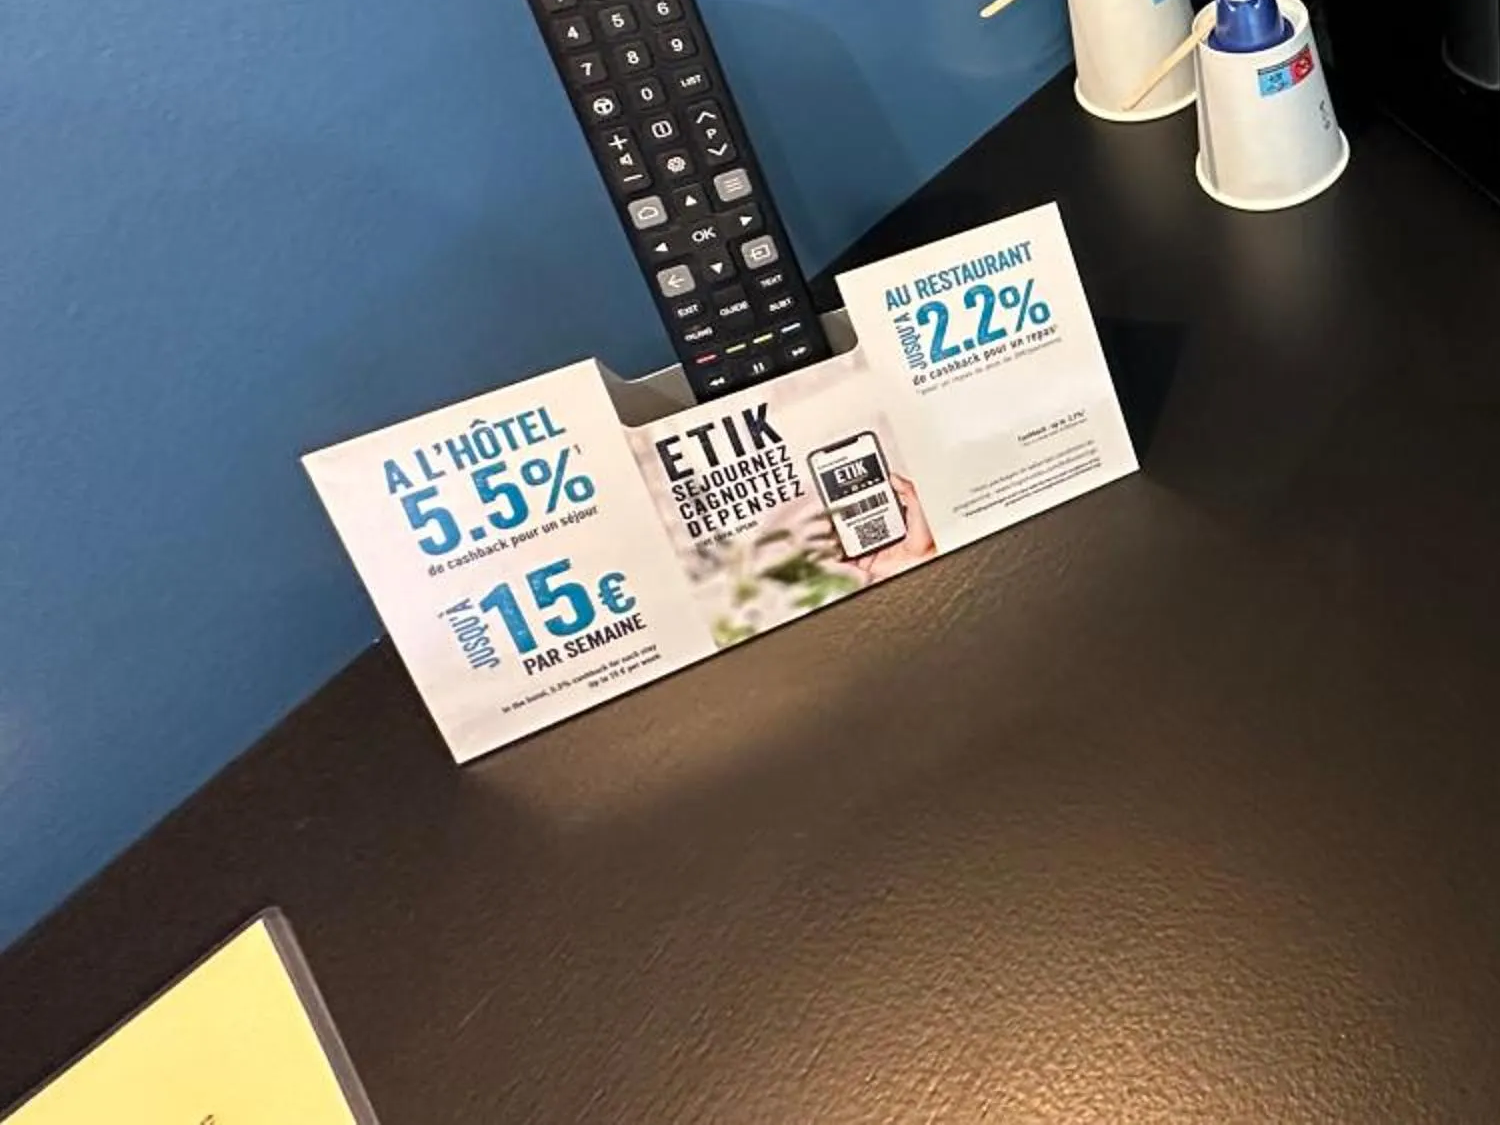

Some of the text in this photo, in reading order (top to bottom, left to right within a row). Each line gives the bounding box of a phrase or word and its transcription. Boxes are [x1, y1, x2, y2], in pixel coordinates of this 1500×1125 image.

[567, 2, 670, 40] 4 5 6
[580, 39, 684, 76] 7 8 9
[641, 74, 701, 101] 0 LIST
[705, 128, 717, 139] P
[691, 226, 717, 243] OK
[885, 241, 1034, 312] AU RESTAURANT
[915, 278, 1052, 365] 2.2%
[927, 354, 981, 378] cashback
[982, 342, 1008, 361] pour
[1010, 337, 1024, 348] un
[383, 406, 566, 495] A L'HÔTEL
[655, 402, 784, 482] ETIK
[671, 444, 791, 502] SEJOURNEZ
[679, 462, 798, 521] CAGNOTTEZ
[834, 460, 869, 484] ETIK
[686, 480, 806, 540] DEPENSEZ
[428, 503, 599, 577] de cashback pour un séjour
[523, 613, 648, 676] PAR SEMAINE
